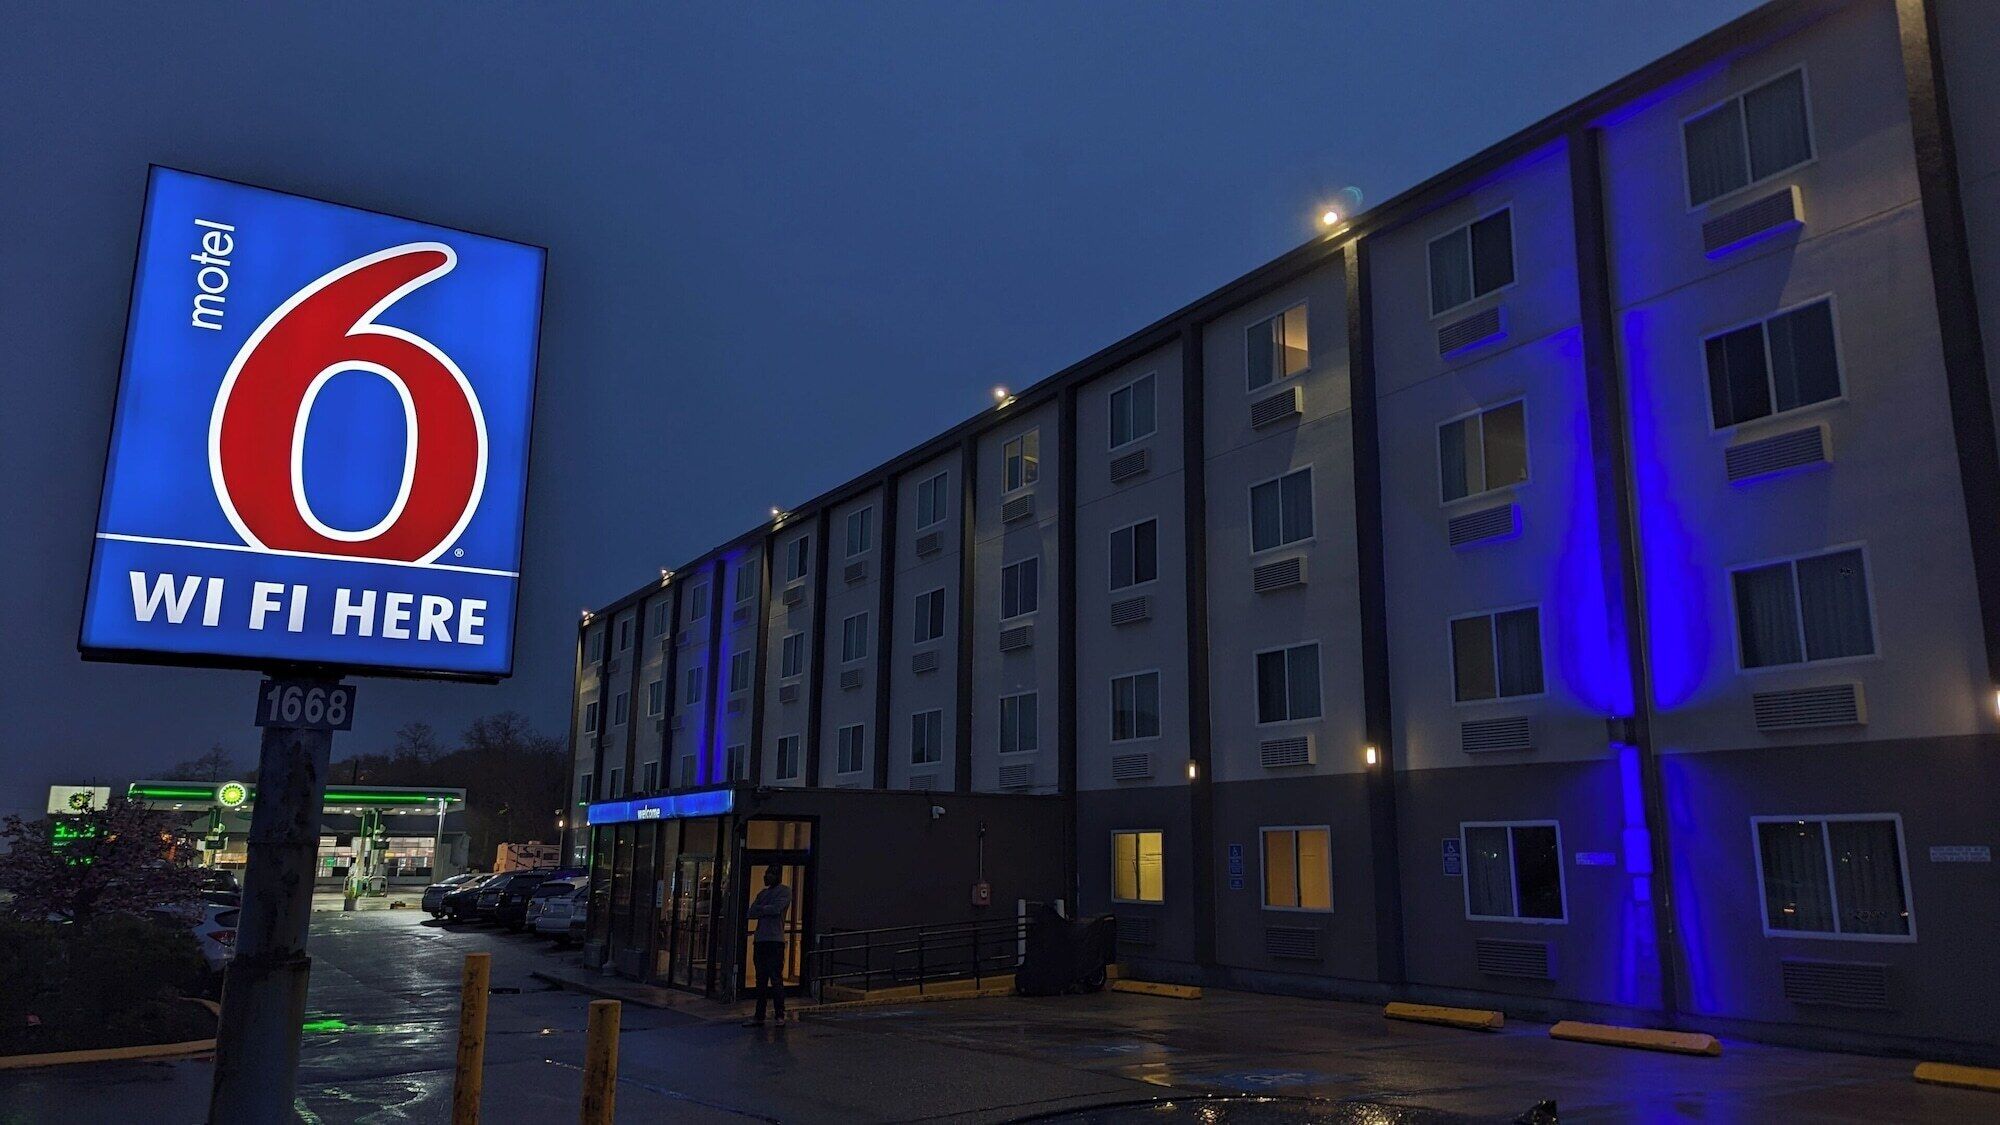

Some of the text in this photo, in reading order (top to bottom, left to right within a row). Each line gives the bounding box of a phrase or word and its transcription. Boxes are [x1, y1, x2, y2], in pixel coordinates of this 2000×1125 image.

[190, 218, 235, 331] motel
[207, 241, 489, 566] 6
[129, 570, 488, 645] WI FI HERE
[266, 685, 348, 726] 1668
[637, 804, 661, 820] welcome
